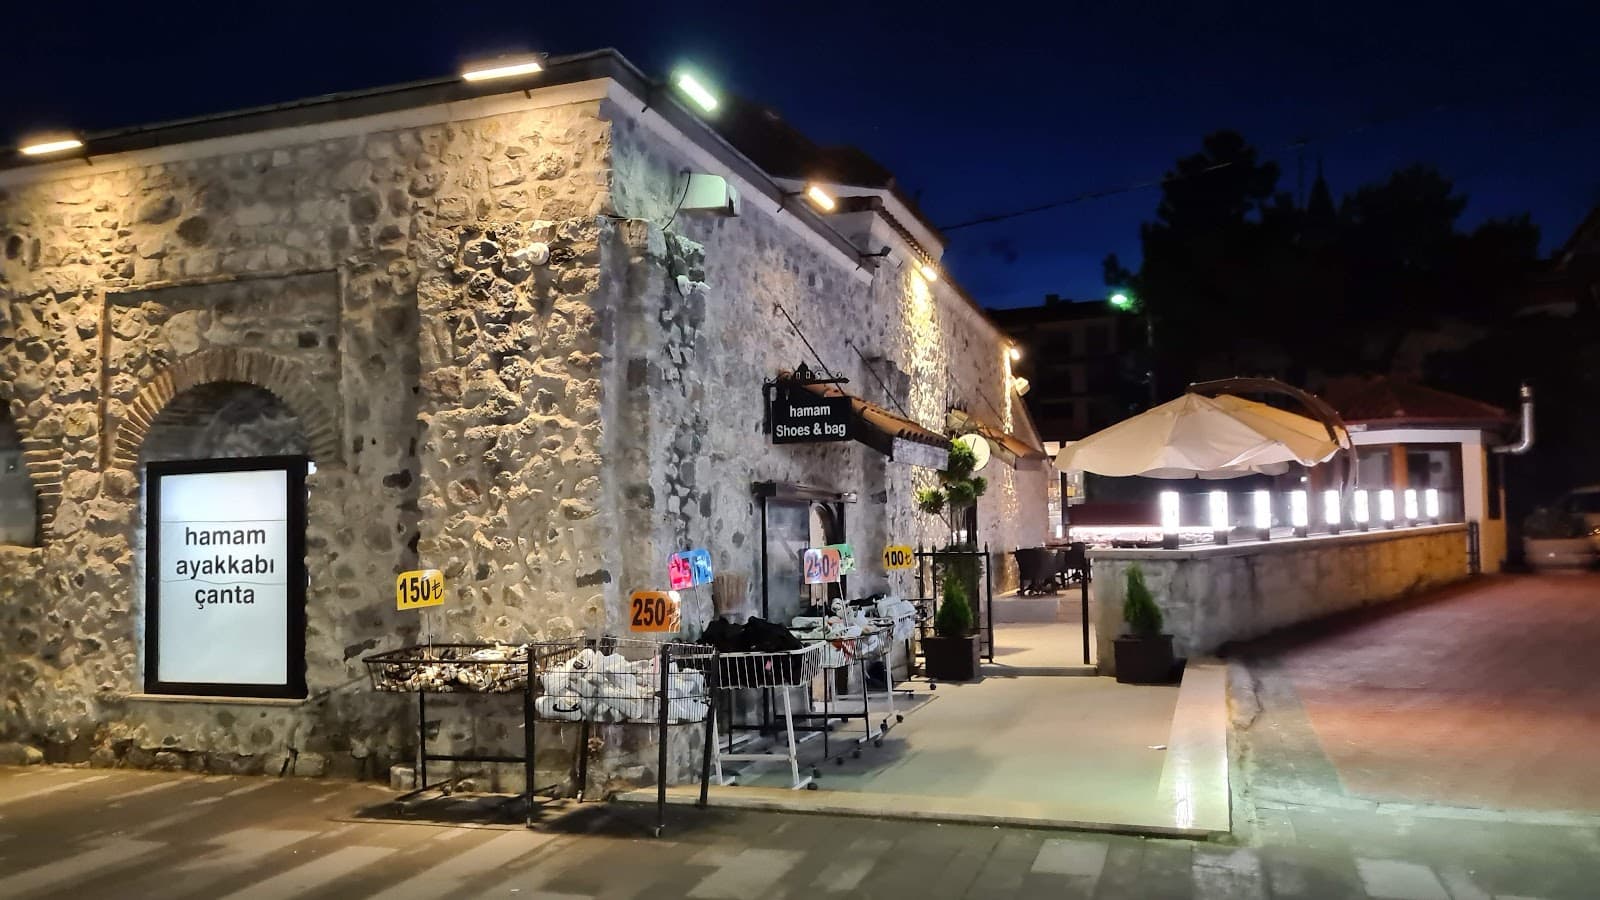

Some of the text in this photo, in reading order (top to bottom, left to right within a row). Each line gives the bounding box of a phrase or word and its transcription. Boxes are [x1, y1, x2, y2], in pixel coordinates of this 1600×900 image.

[789, 405, 831, 418] hamam
[776, 422, 846, 438] Shoes & bag
[185, 526, 266, 546] hamam
[176, 554, 275, 580] ayakkabı
[195, 585, 255, 610] çanta
